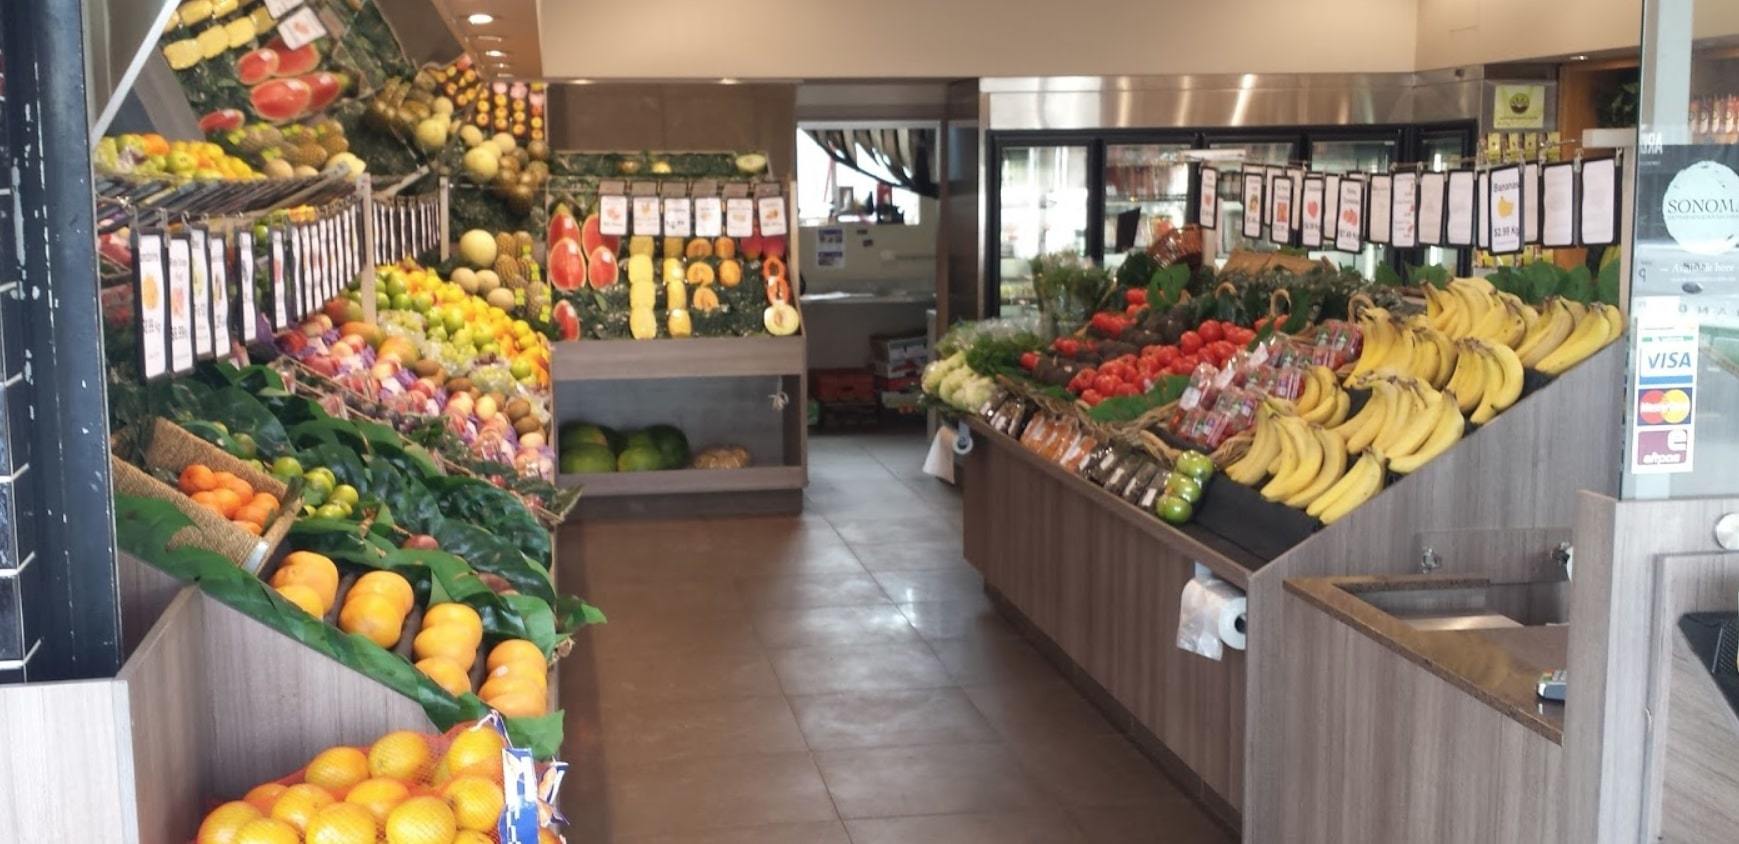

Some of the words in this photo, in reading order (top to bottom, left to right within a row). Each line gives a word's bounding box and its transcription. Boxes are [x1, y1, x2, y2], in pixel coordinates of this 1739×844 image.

[1493, 181, 1520, 193] Bananas
[1667, 198, 1739, 215] SONOM
[1648, 351, 1692, 369] VISA
